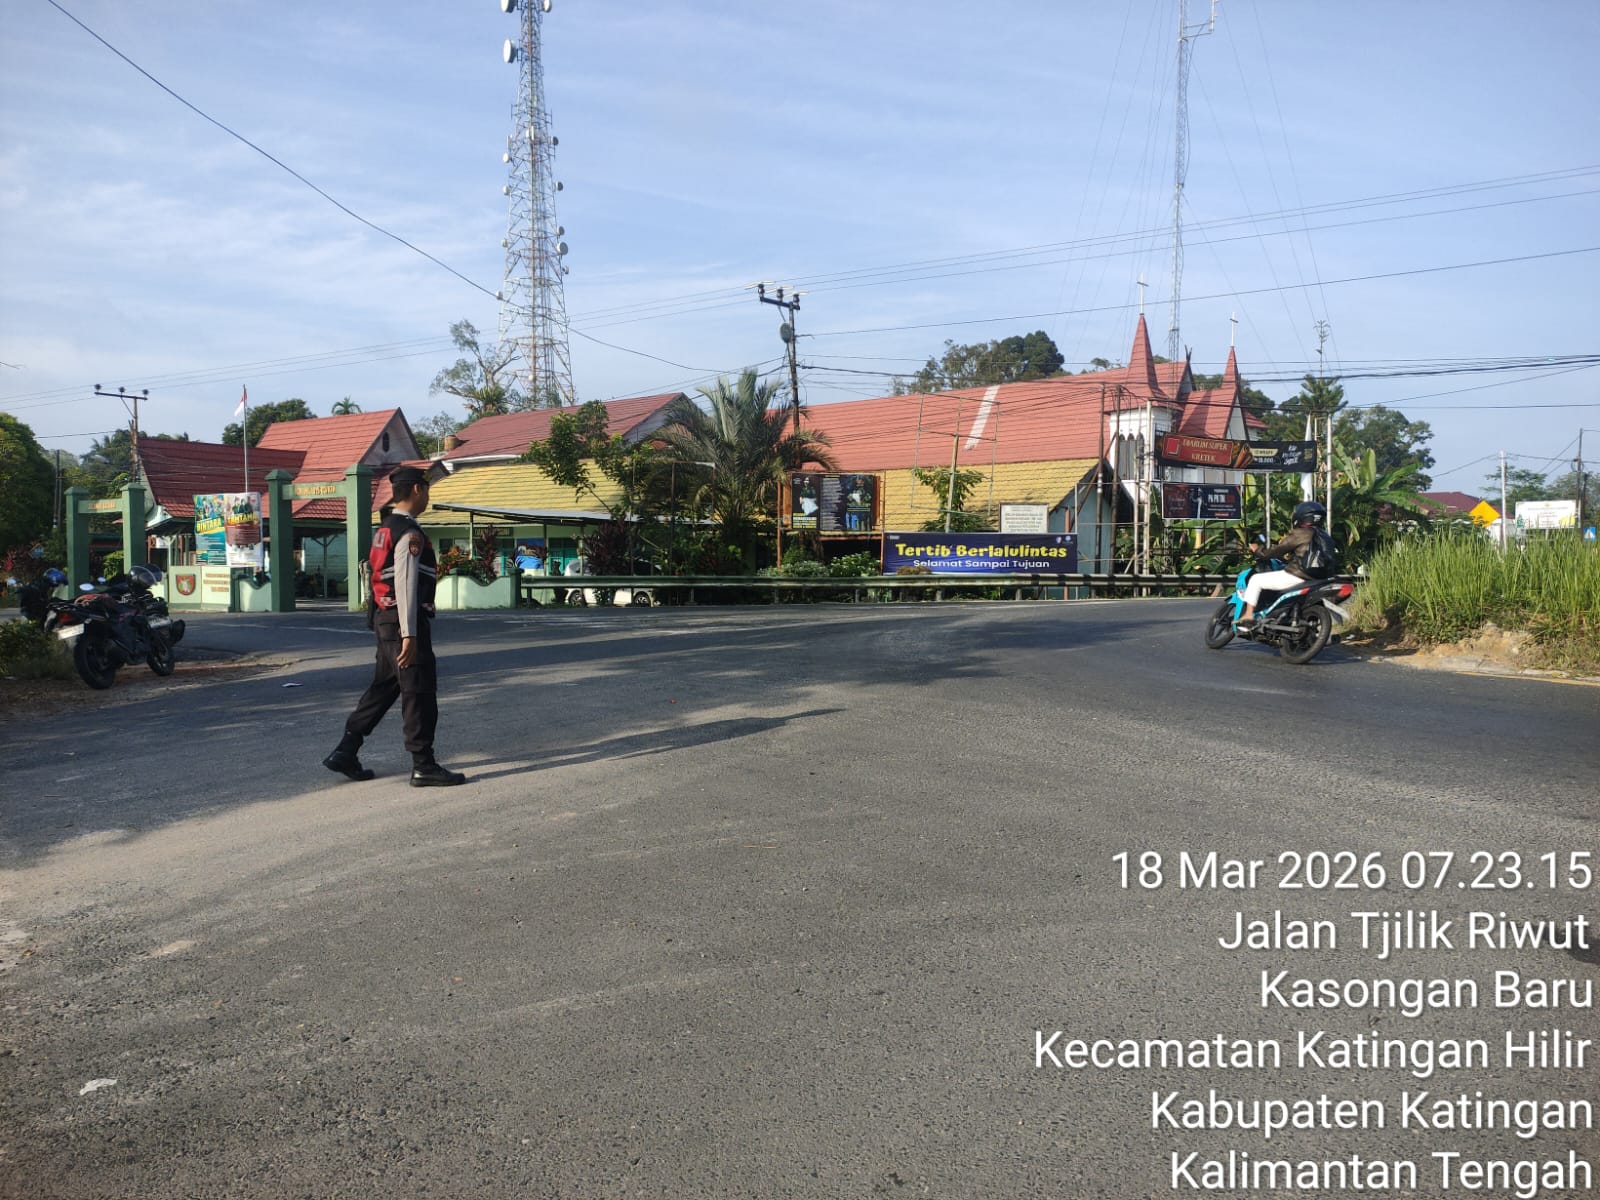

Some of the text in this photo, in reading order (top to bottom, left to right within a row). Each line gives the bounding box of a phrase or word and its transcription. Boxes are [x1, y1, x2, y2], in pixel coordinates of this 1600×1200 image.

[895, 543, 1068, 558] Tertib Berlalulintas
[913, 559, 1050, 570] Selamat Sampai Tujuan
